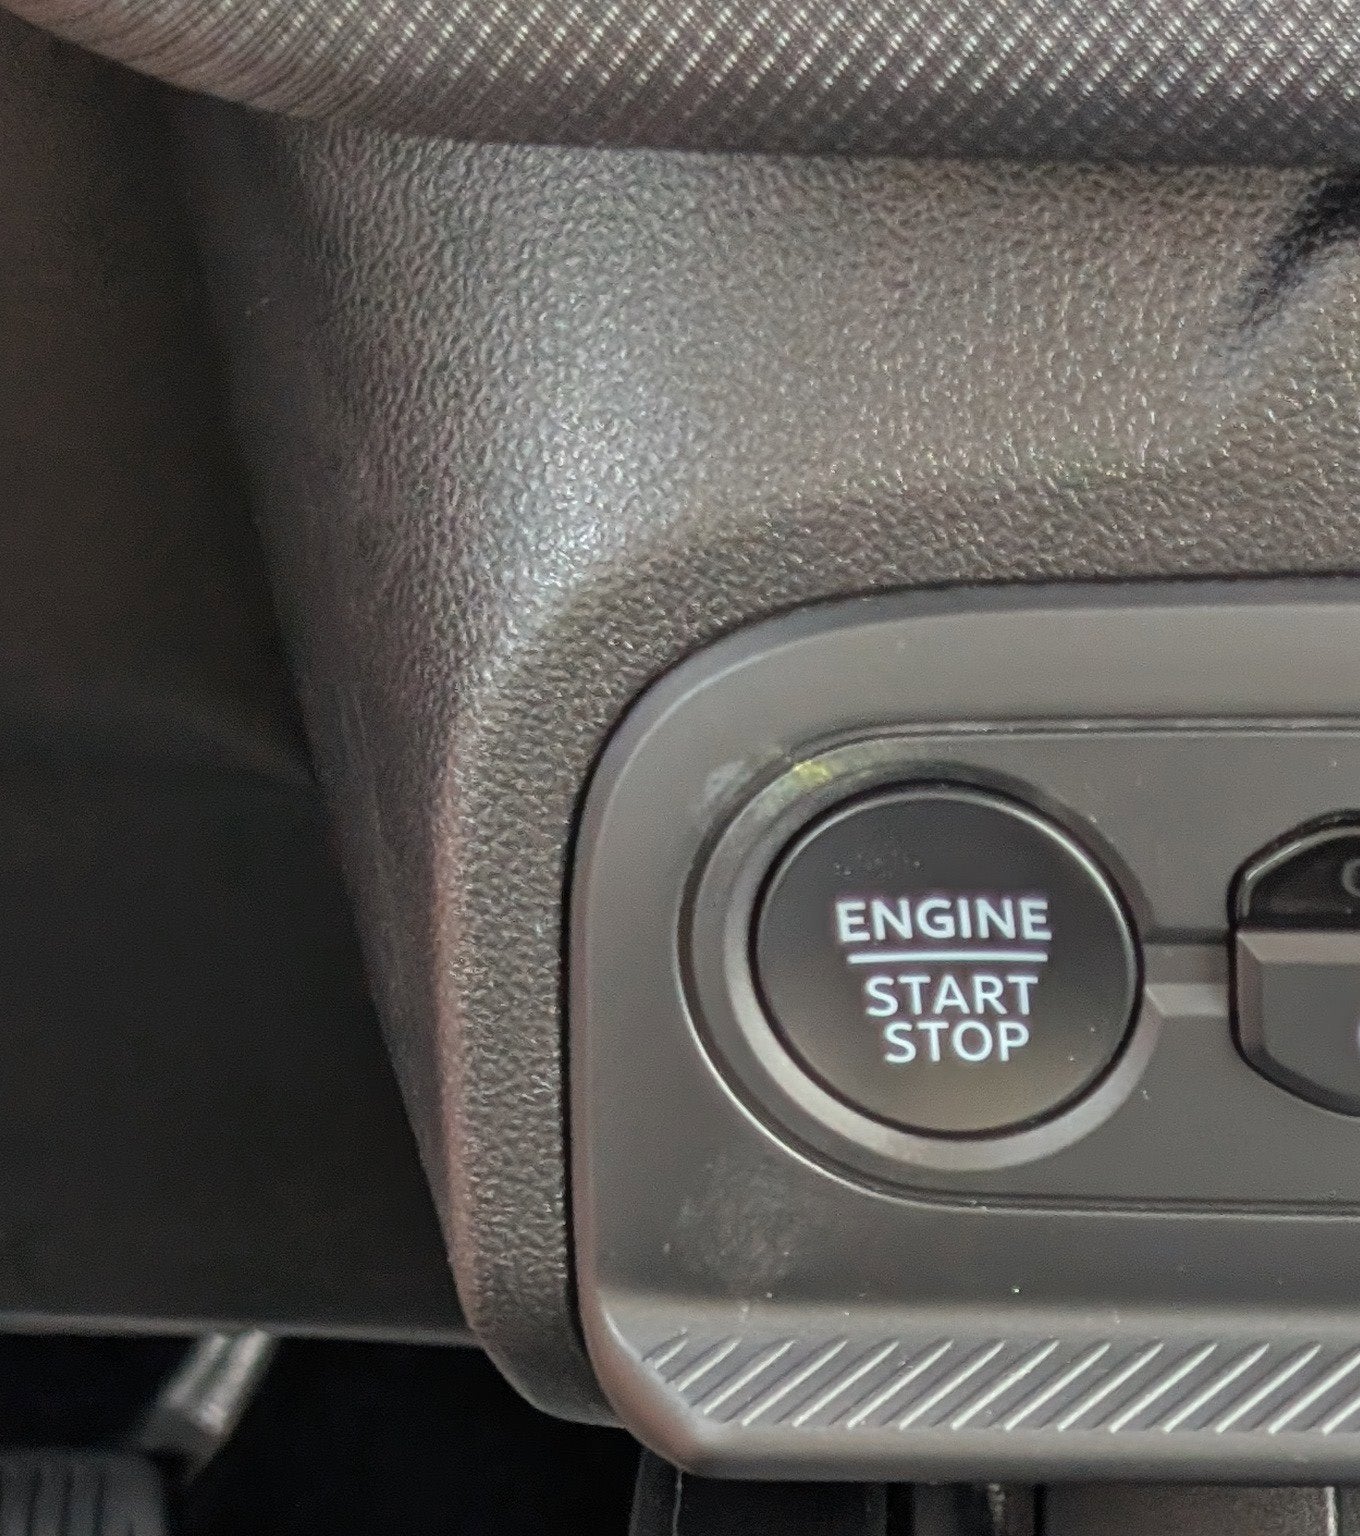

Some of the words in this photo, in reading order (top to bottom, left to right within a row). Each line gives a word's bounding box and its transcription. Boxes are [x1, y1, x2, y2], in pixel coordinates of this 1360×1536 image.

[836, 898, 1052, 943] ENGINE
[864, 974, 1038, 1017] START
[884, 1020, 1030, 1063] STOP
